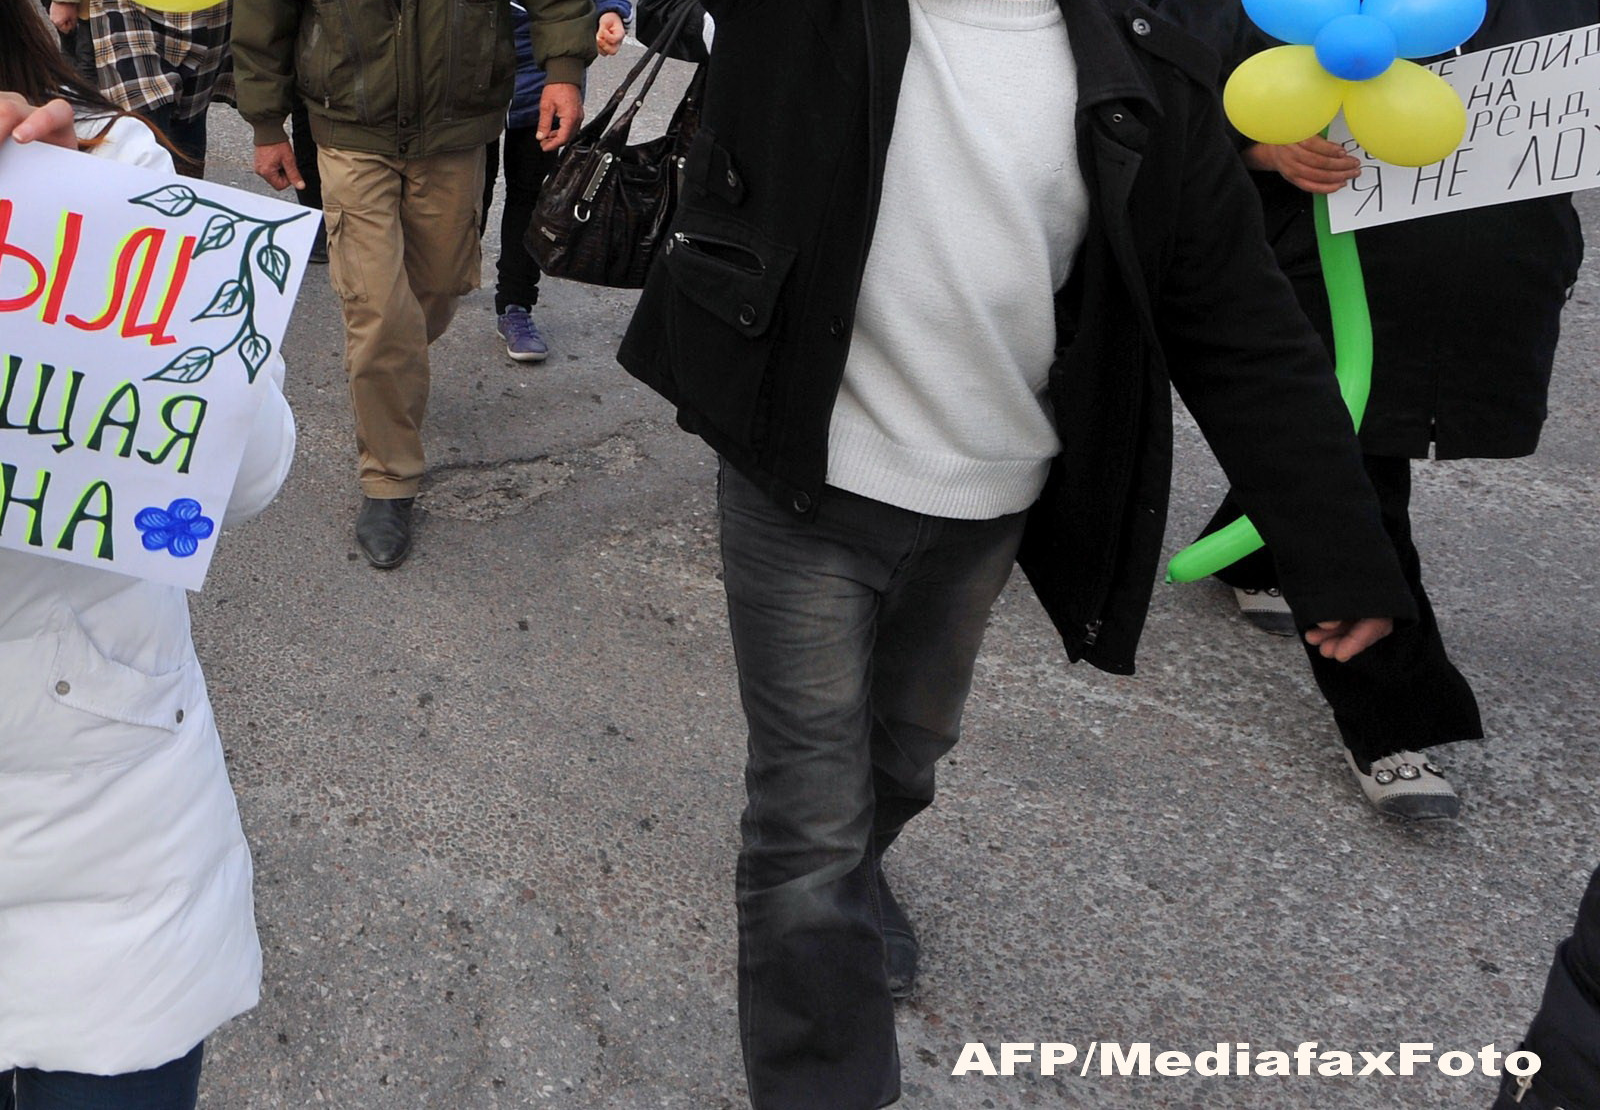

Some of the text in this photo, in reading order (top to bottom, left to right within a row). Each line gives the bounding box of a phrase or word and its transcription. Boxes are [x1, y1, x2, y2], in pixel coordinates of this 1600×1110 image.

[1467, 78, 1517, 110] НА
[1351, 125, 1600, 217] Я НЕ ЛО
